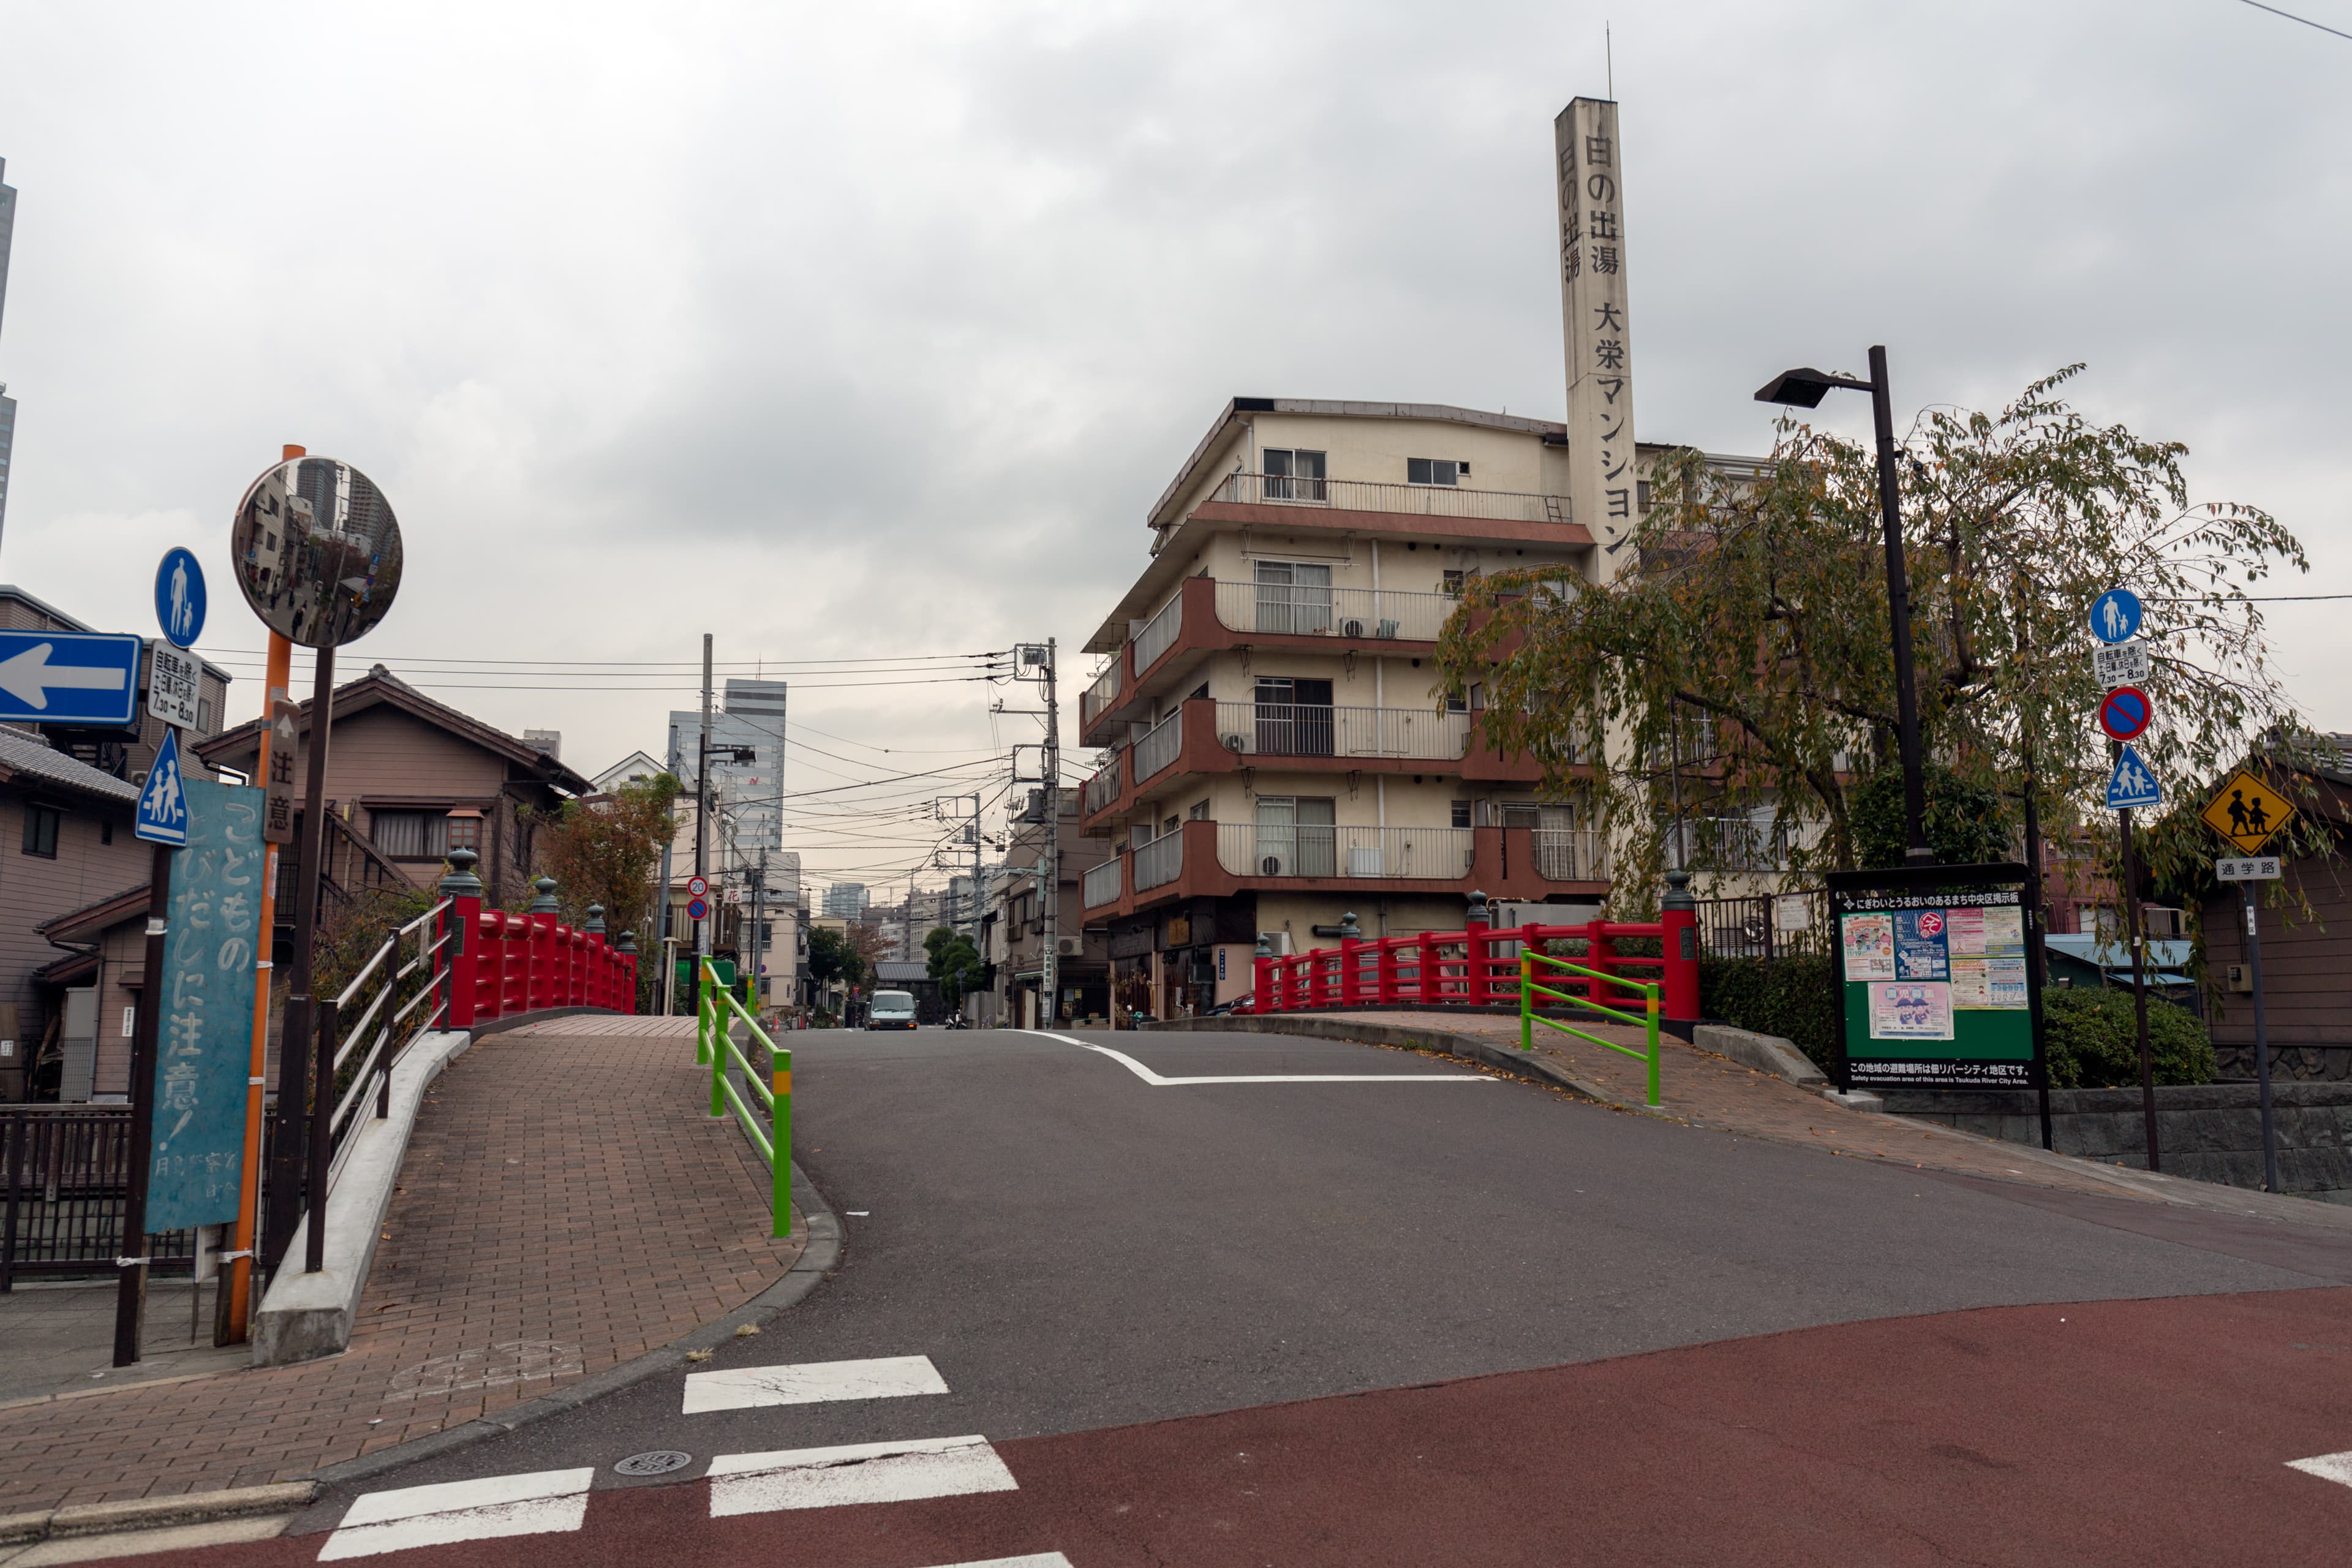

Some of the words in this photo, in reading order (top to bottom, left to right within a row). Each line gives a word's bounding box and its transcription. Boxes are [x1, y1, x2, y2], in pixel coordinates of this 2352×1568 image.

[1560, 139, 1581, 285] 日の出湯
[1586, 135, 1619, 276] 日の出湯
[156, 650, 197, 683] 自転車を除く
[2097, 646, 2142, 662] 自転車を除く
[269, 750, 293, 831] 注意
[2222, 861, 2274, 875] 通学路
[217, 803, 258, 973] こどもの
[692, 882, 704, 892] 20
[727, 889, 739, 902] 花
[1856, 892, 2019, 910] にぎわいとうるおいのあるまち中央区掲示板
